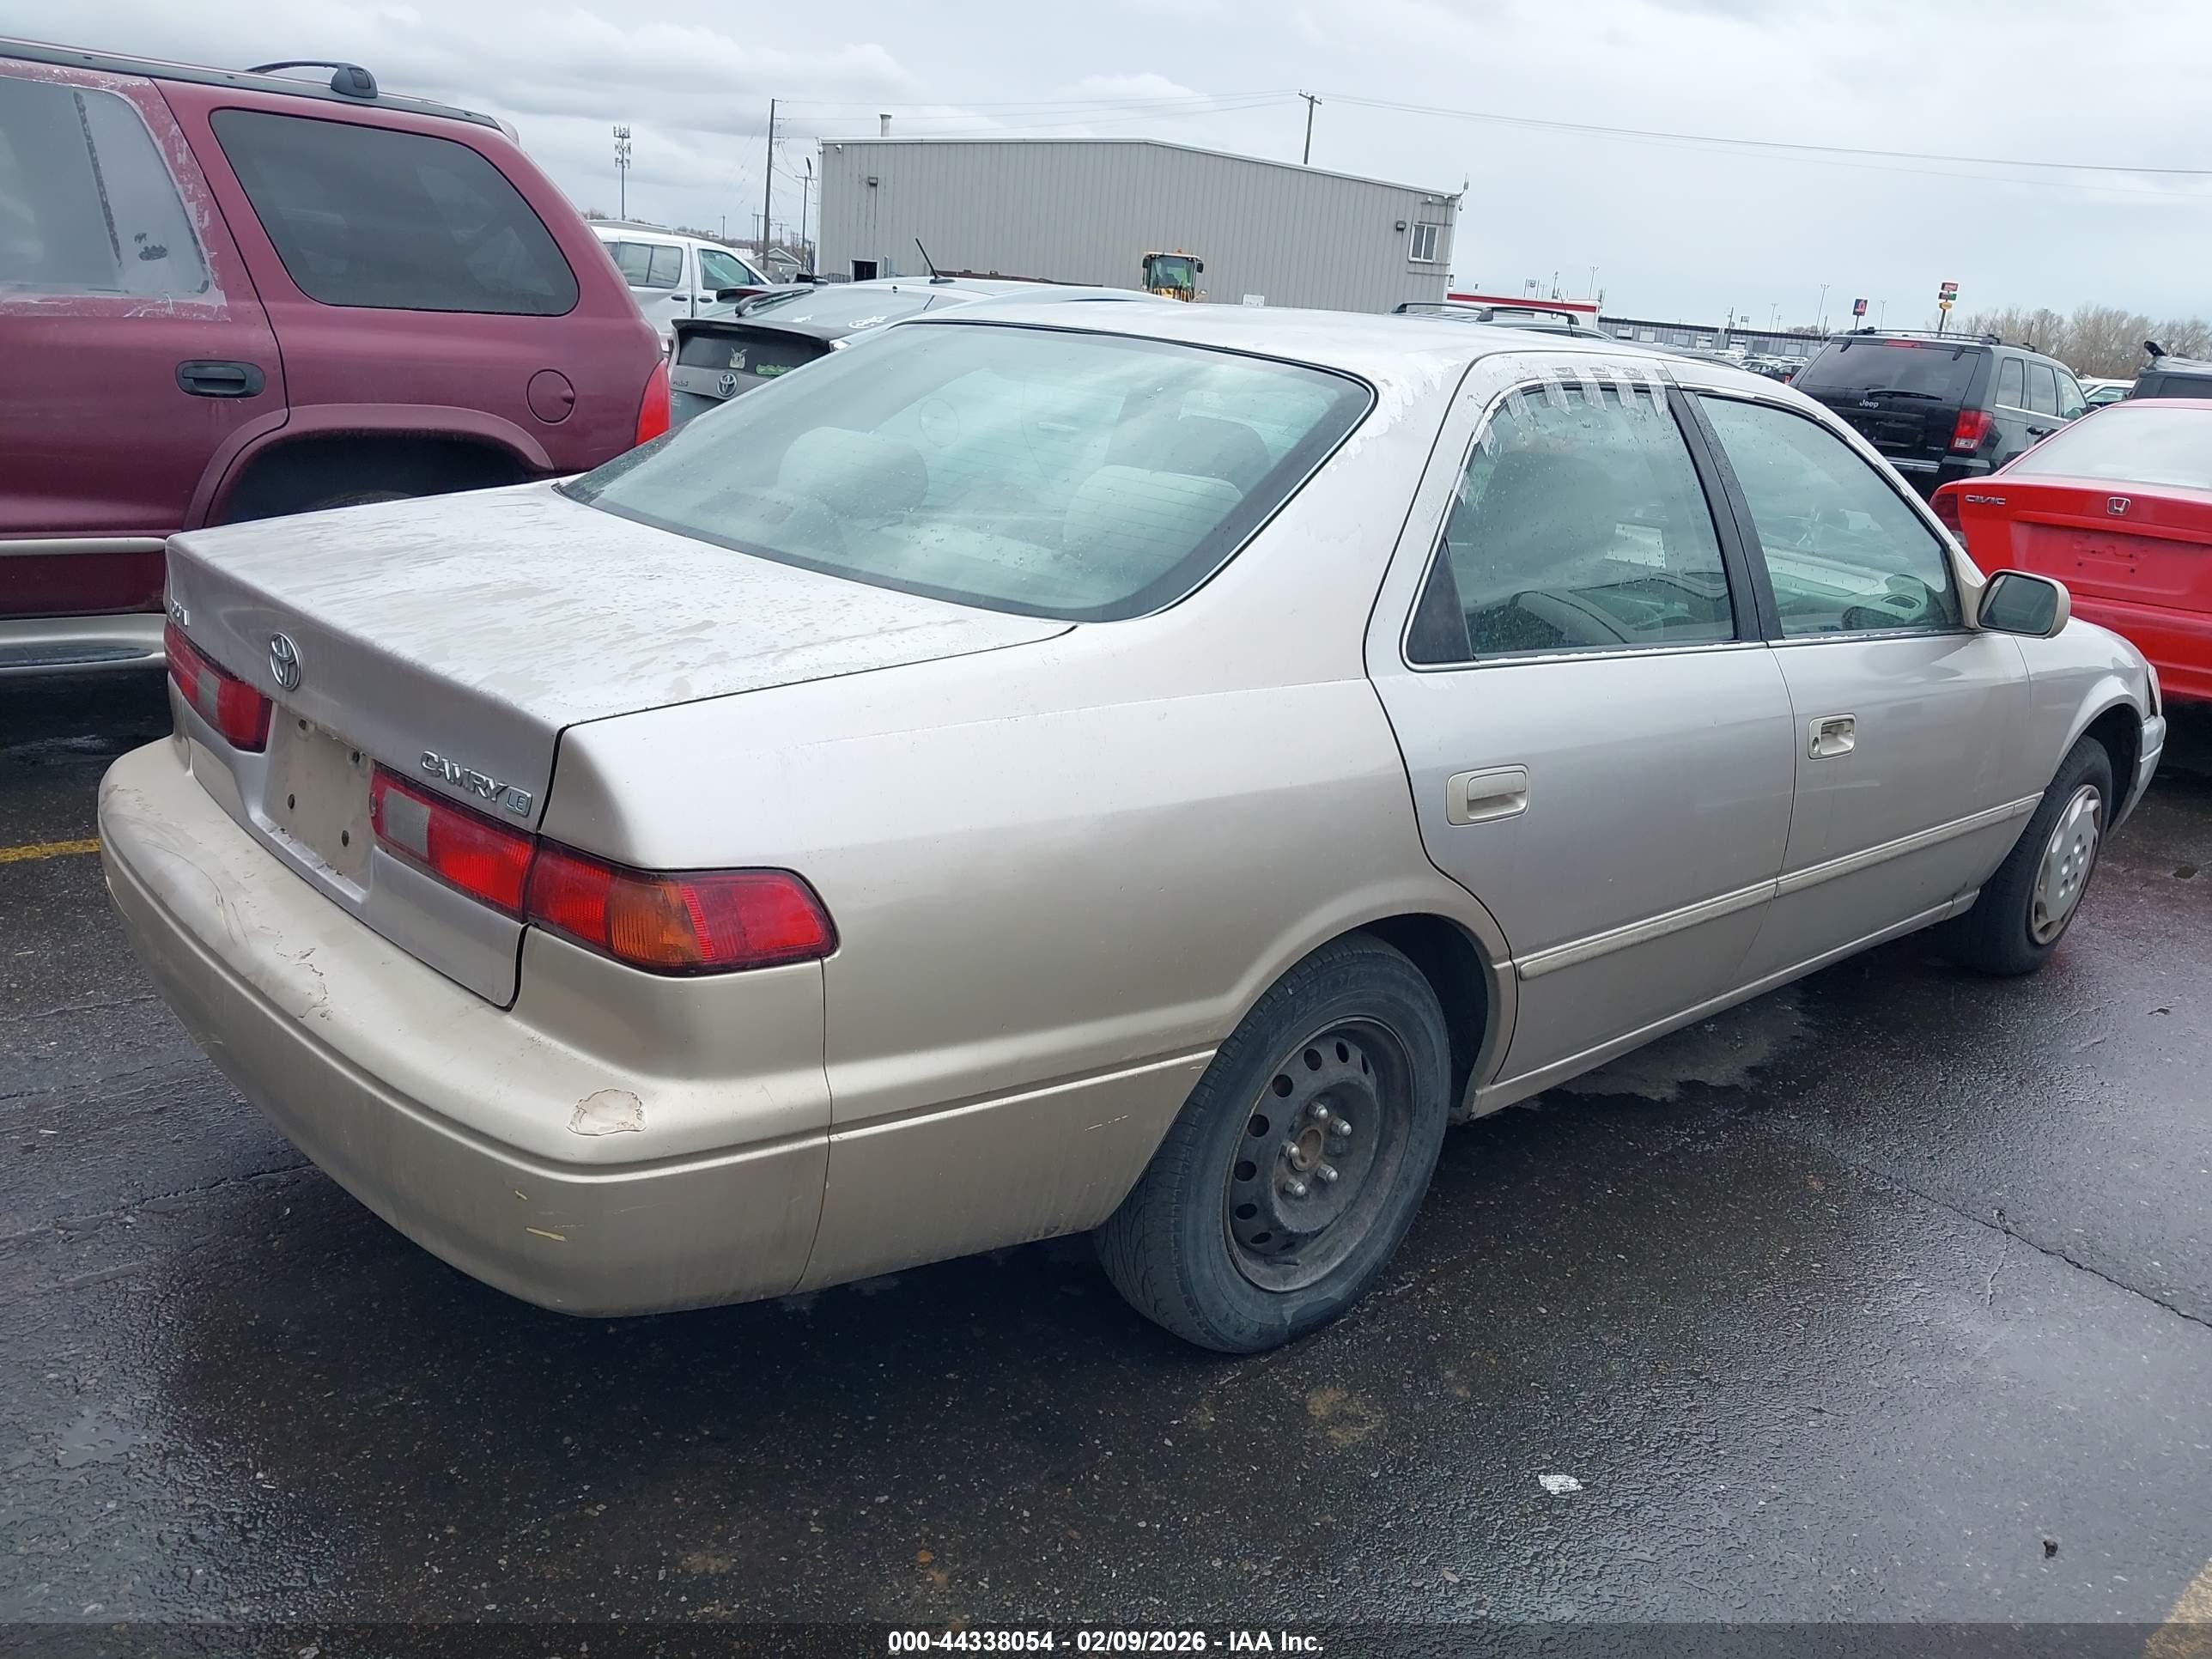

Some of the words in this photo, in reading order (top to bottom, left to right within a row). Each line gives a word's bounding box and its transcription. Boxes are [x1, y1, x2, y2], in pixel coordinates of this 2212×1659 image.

[1858, 398, 1880, 410] Jeep
[1965, 494, 2006, 506] CIVIC
[420, 750, 509, 803] CAMRY
[506, 787, 531, 817] LE
